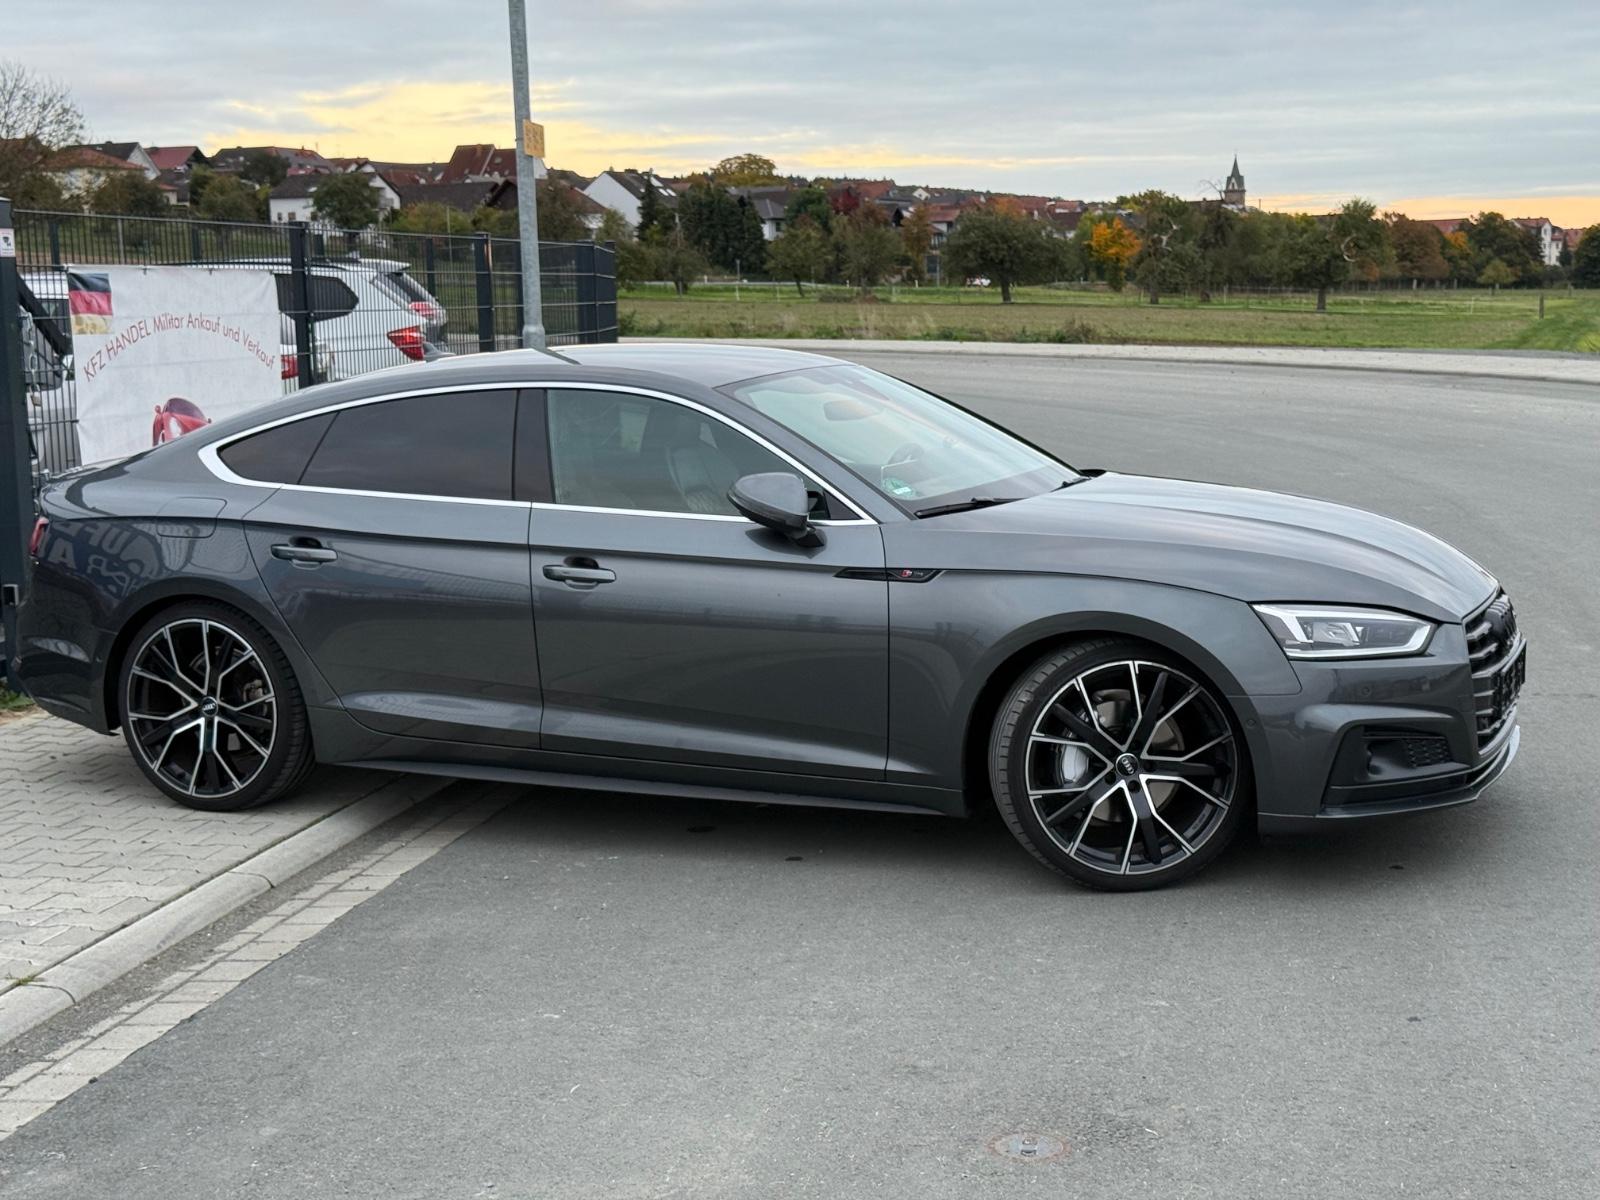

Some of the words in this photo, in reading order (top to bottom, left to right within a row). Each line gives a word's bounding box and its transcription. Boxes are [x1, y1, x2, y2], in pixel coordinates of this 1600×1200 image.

[83, 350, 106, 382] KFZ
[105, 319, 151, 360] HANDEL
[187, 312, 221, 334] Ankauf
[223, 326, 241, 342] und
[242, 330, 276, 369] Verkauf
